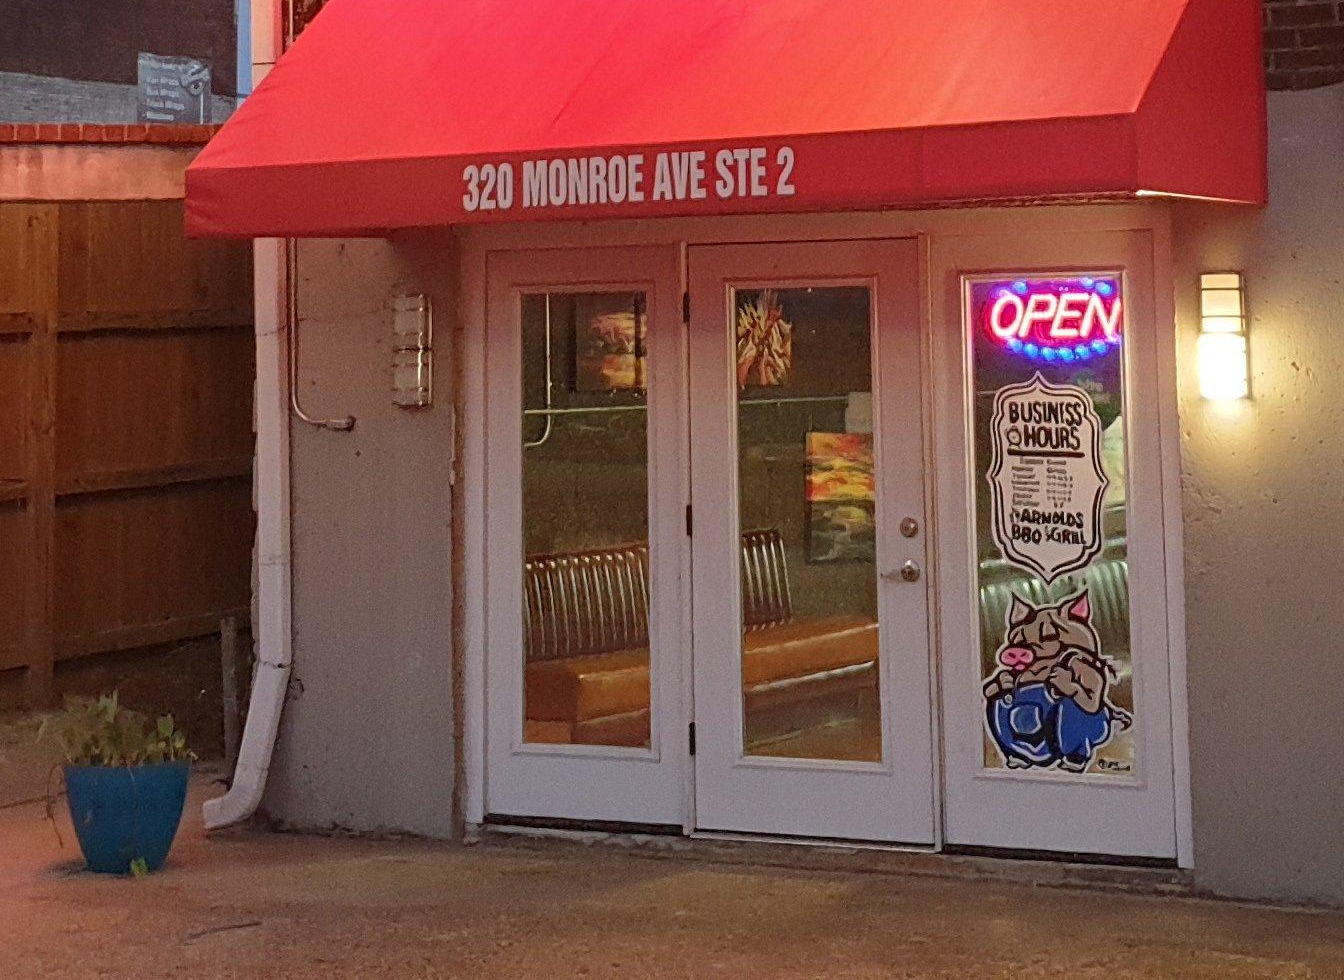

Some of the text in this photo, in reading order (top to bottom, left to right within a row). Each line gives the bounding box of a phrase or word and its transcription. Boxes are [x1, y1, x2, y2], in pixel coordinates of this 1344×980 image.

[462, 146, 795, 211] 320 MONROE AVE STE 2
[991, 292, 1122, 339] OPEN
[1023, 424, 1081, 451] HOURS
